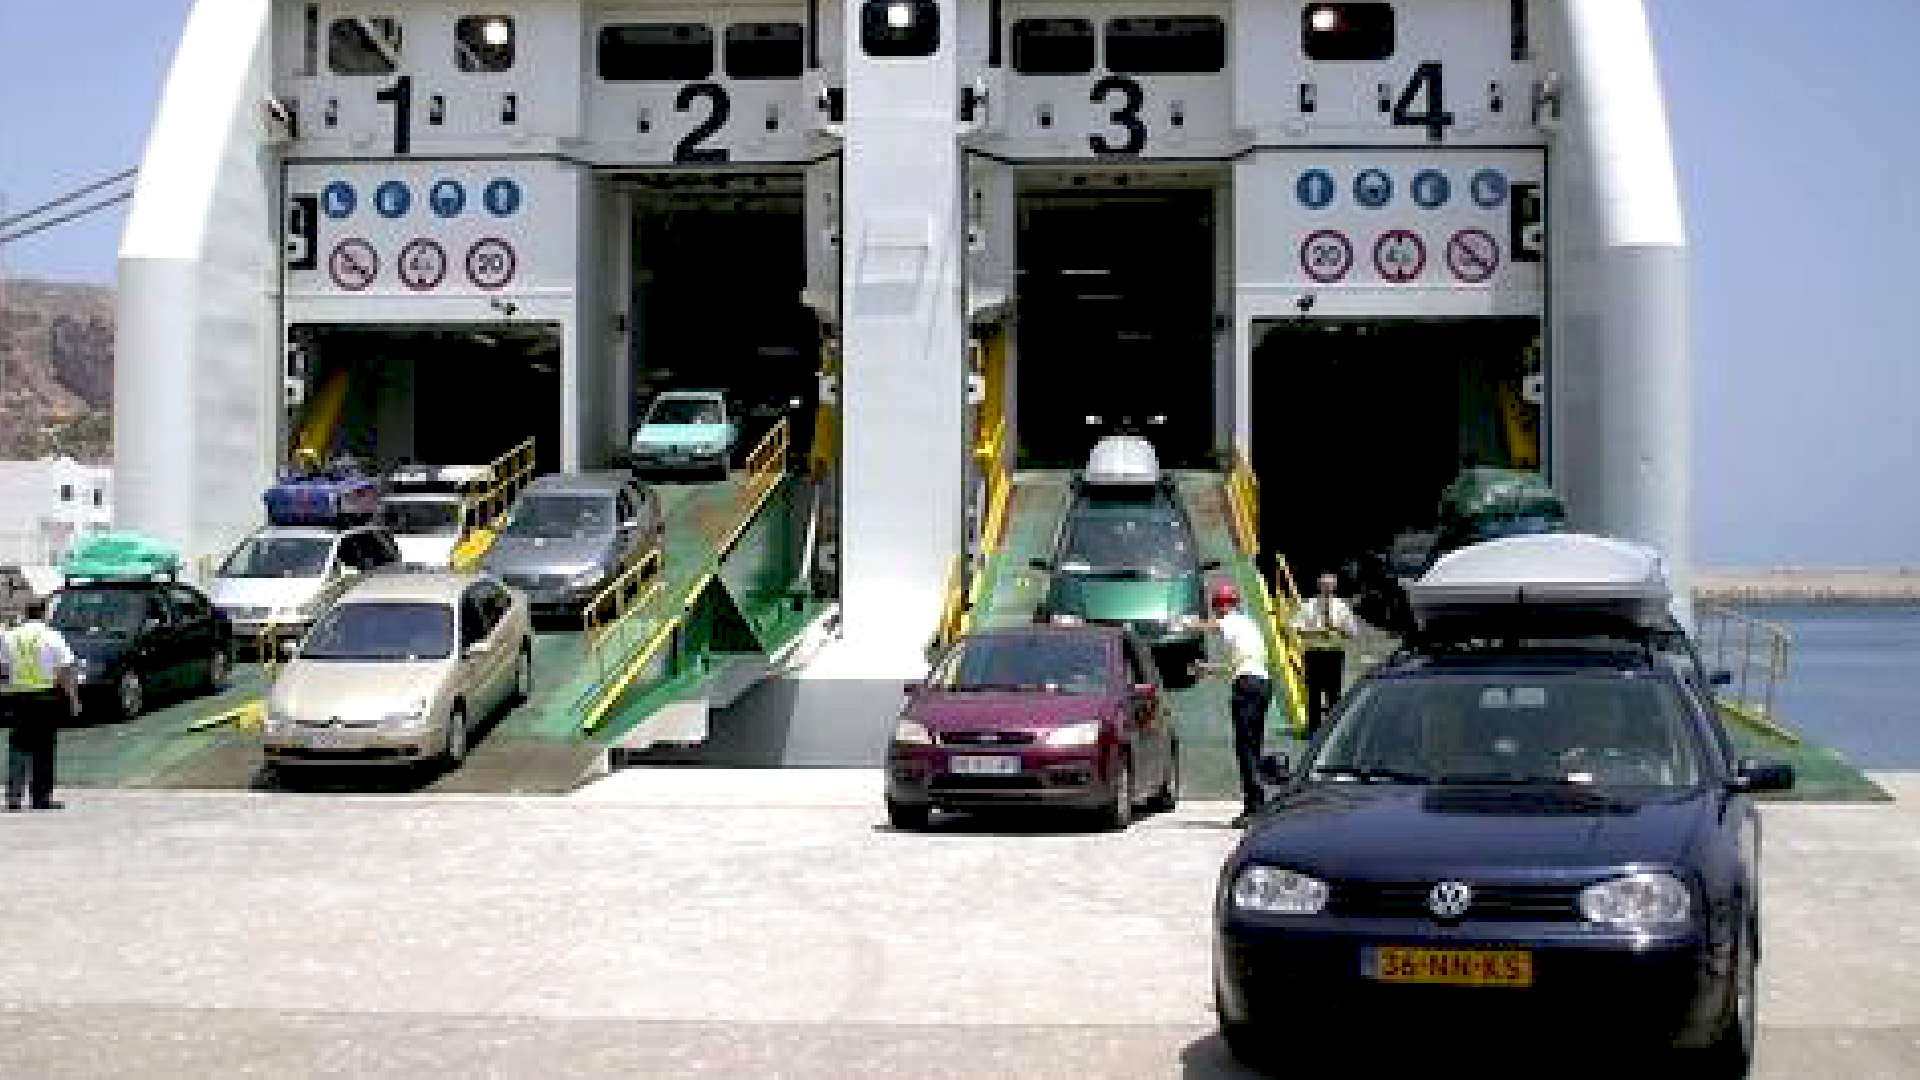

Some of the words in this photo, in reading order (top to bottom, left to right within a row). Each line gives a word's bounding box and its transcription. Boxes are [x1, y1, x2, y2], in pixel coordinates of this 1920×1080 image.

[377, 76, 410, 154] 1
[674, 82, 731, 163] 2
[1089, 76, 1147, 154] 3
[1391, 63, 1455, 141] 4
[478, 253, 504, 274] 20
[1313, 245, 1341, 267] 20
